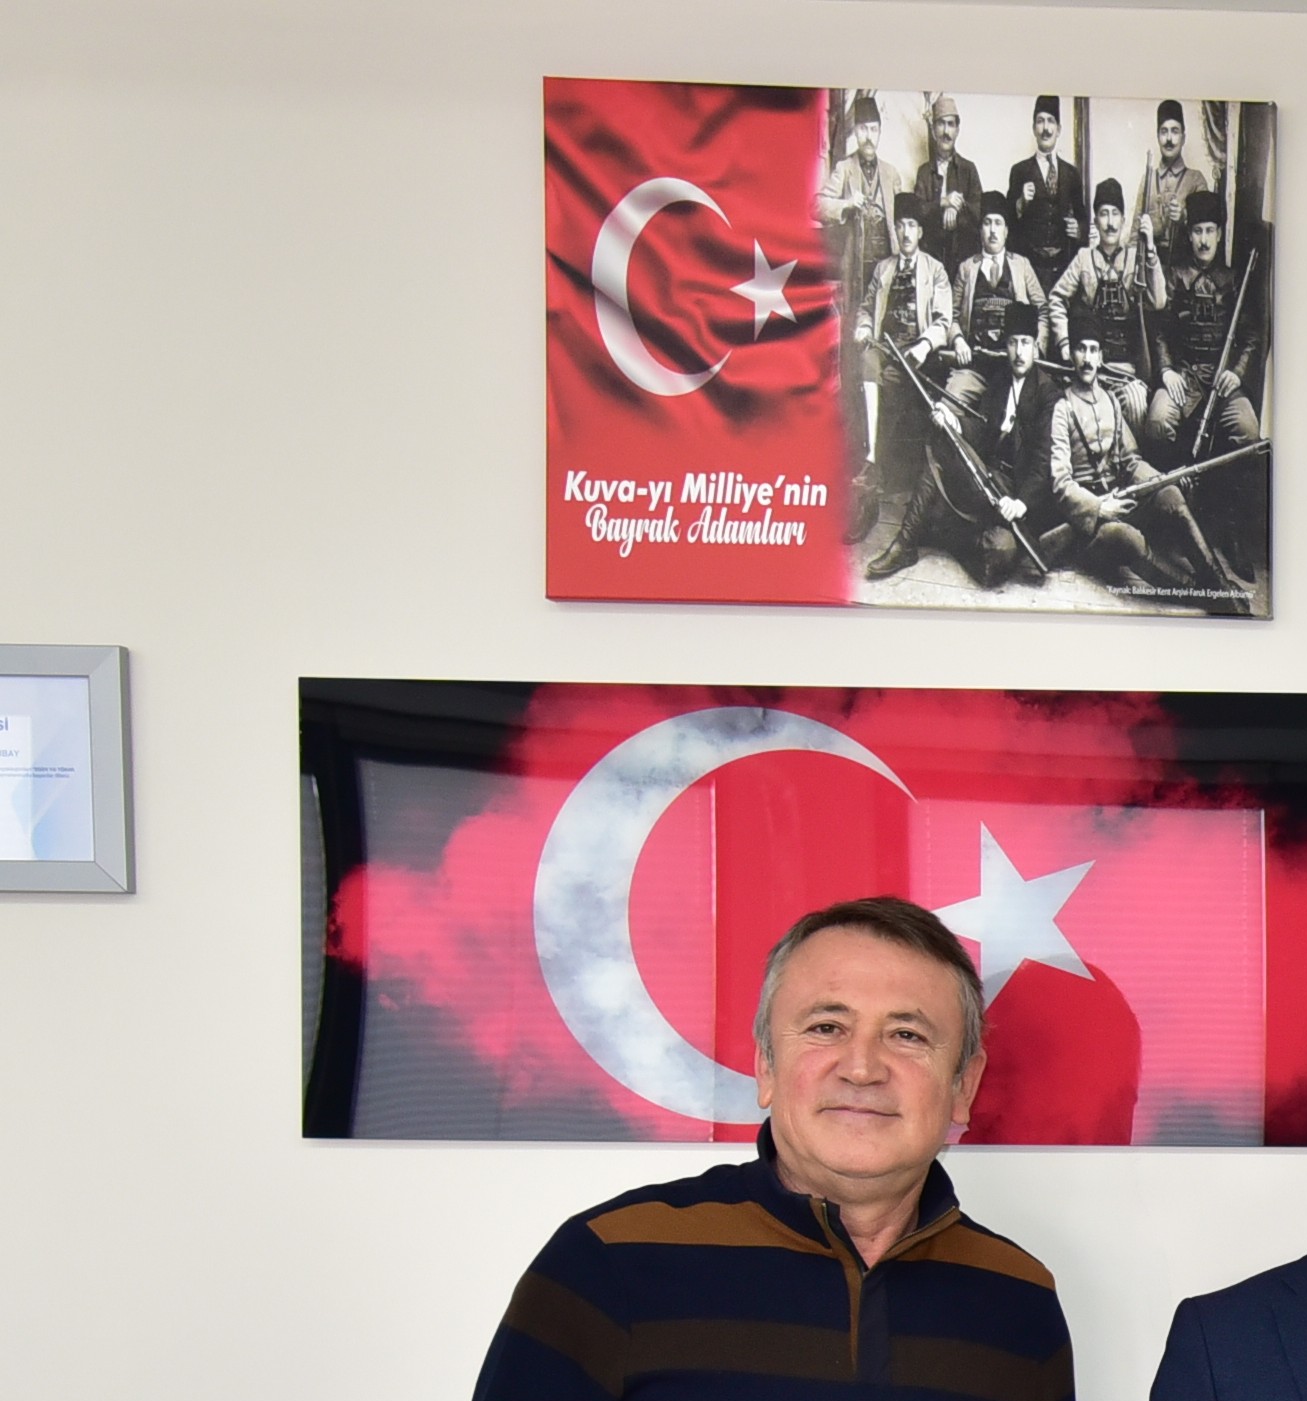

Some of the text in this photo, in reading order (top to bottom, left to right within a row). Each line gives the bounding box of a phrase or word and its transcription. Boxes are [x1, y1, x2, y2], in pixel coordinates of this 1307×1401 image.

[564, 470, 828, 513] Kuva-yı Milliye'nin
[585, 503, 807, 558] Bayrak Adamları
